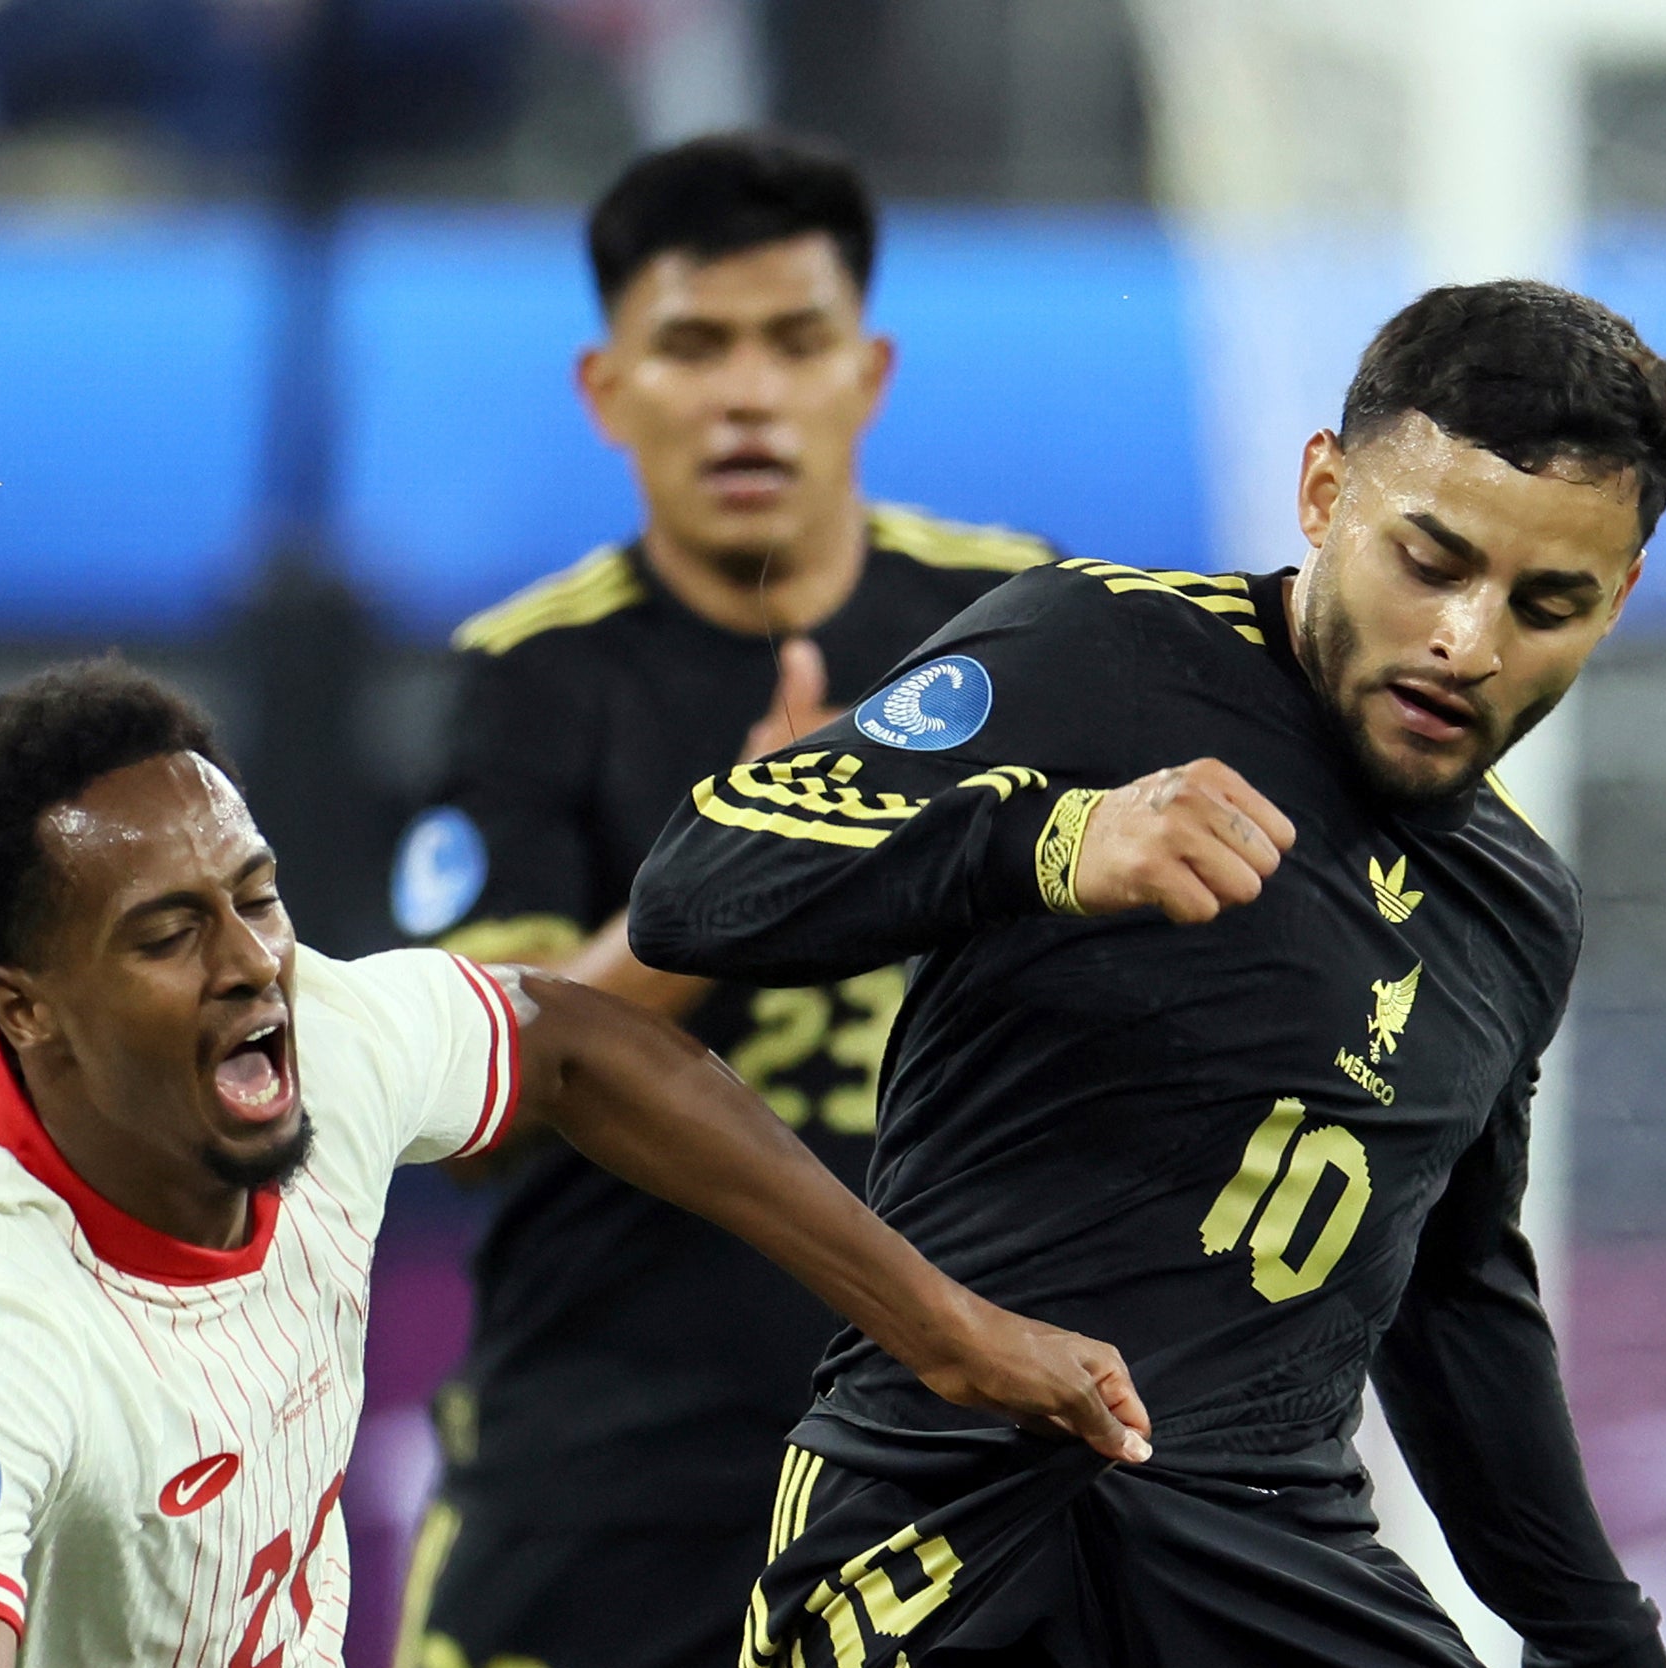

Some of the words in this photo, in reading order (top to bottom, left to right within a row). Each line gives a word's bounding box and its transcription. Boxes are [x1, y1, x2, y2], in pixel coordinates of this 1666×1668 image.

[862, 719, 909, 746] FINALS
[733, 964, 904, 1136] 23
[1333, 1046, 1395, 1107] MÉXICO
[1197, 1096, 1374, 1305] 10
